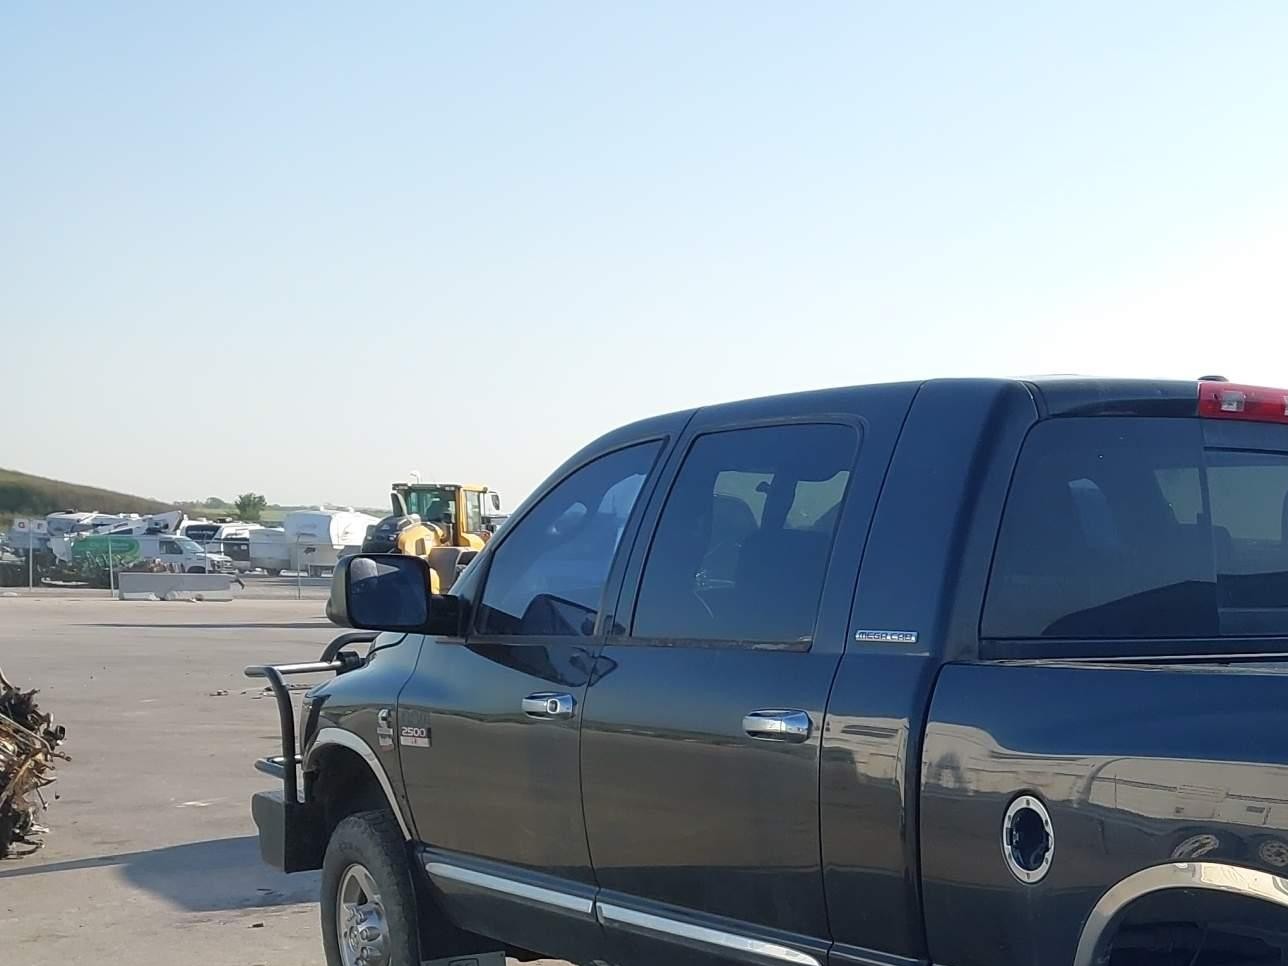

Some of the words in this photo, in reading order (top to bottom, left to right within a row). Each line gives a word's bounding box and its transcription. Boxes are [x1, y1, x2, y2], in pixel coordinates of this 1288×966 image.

[858, 631, 887, 640] MEGA
[890, 632, 912, 641] CAB
[401, 726, 426, 737] 2500
